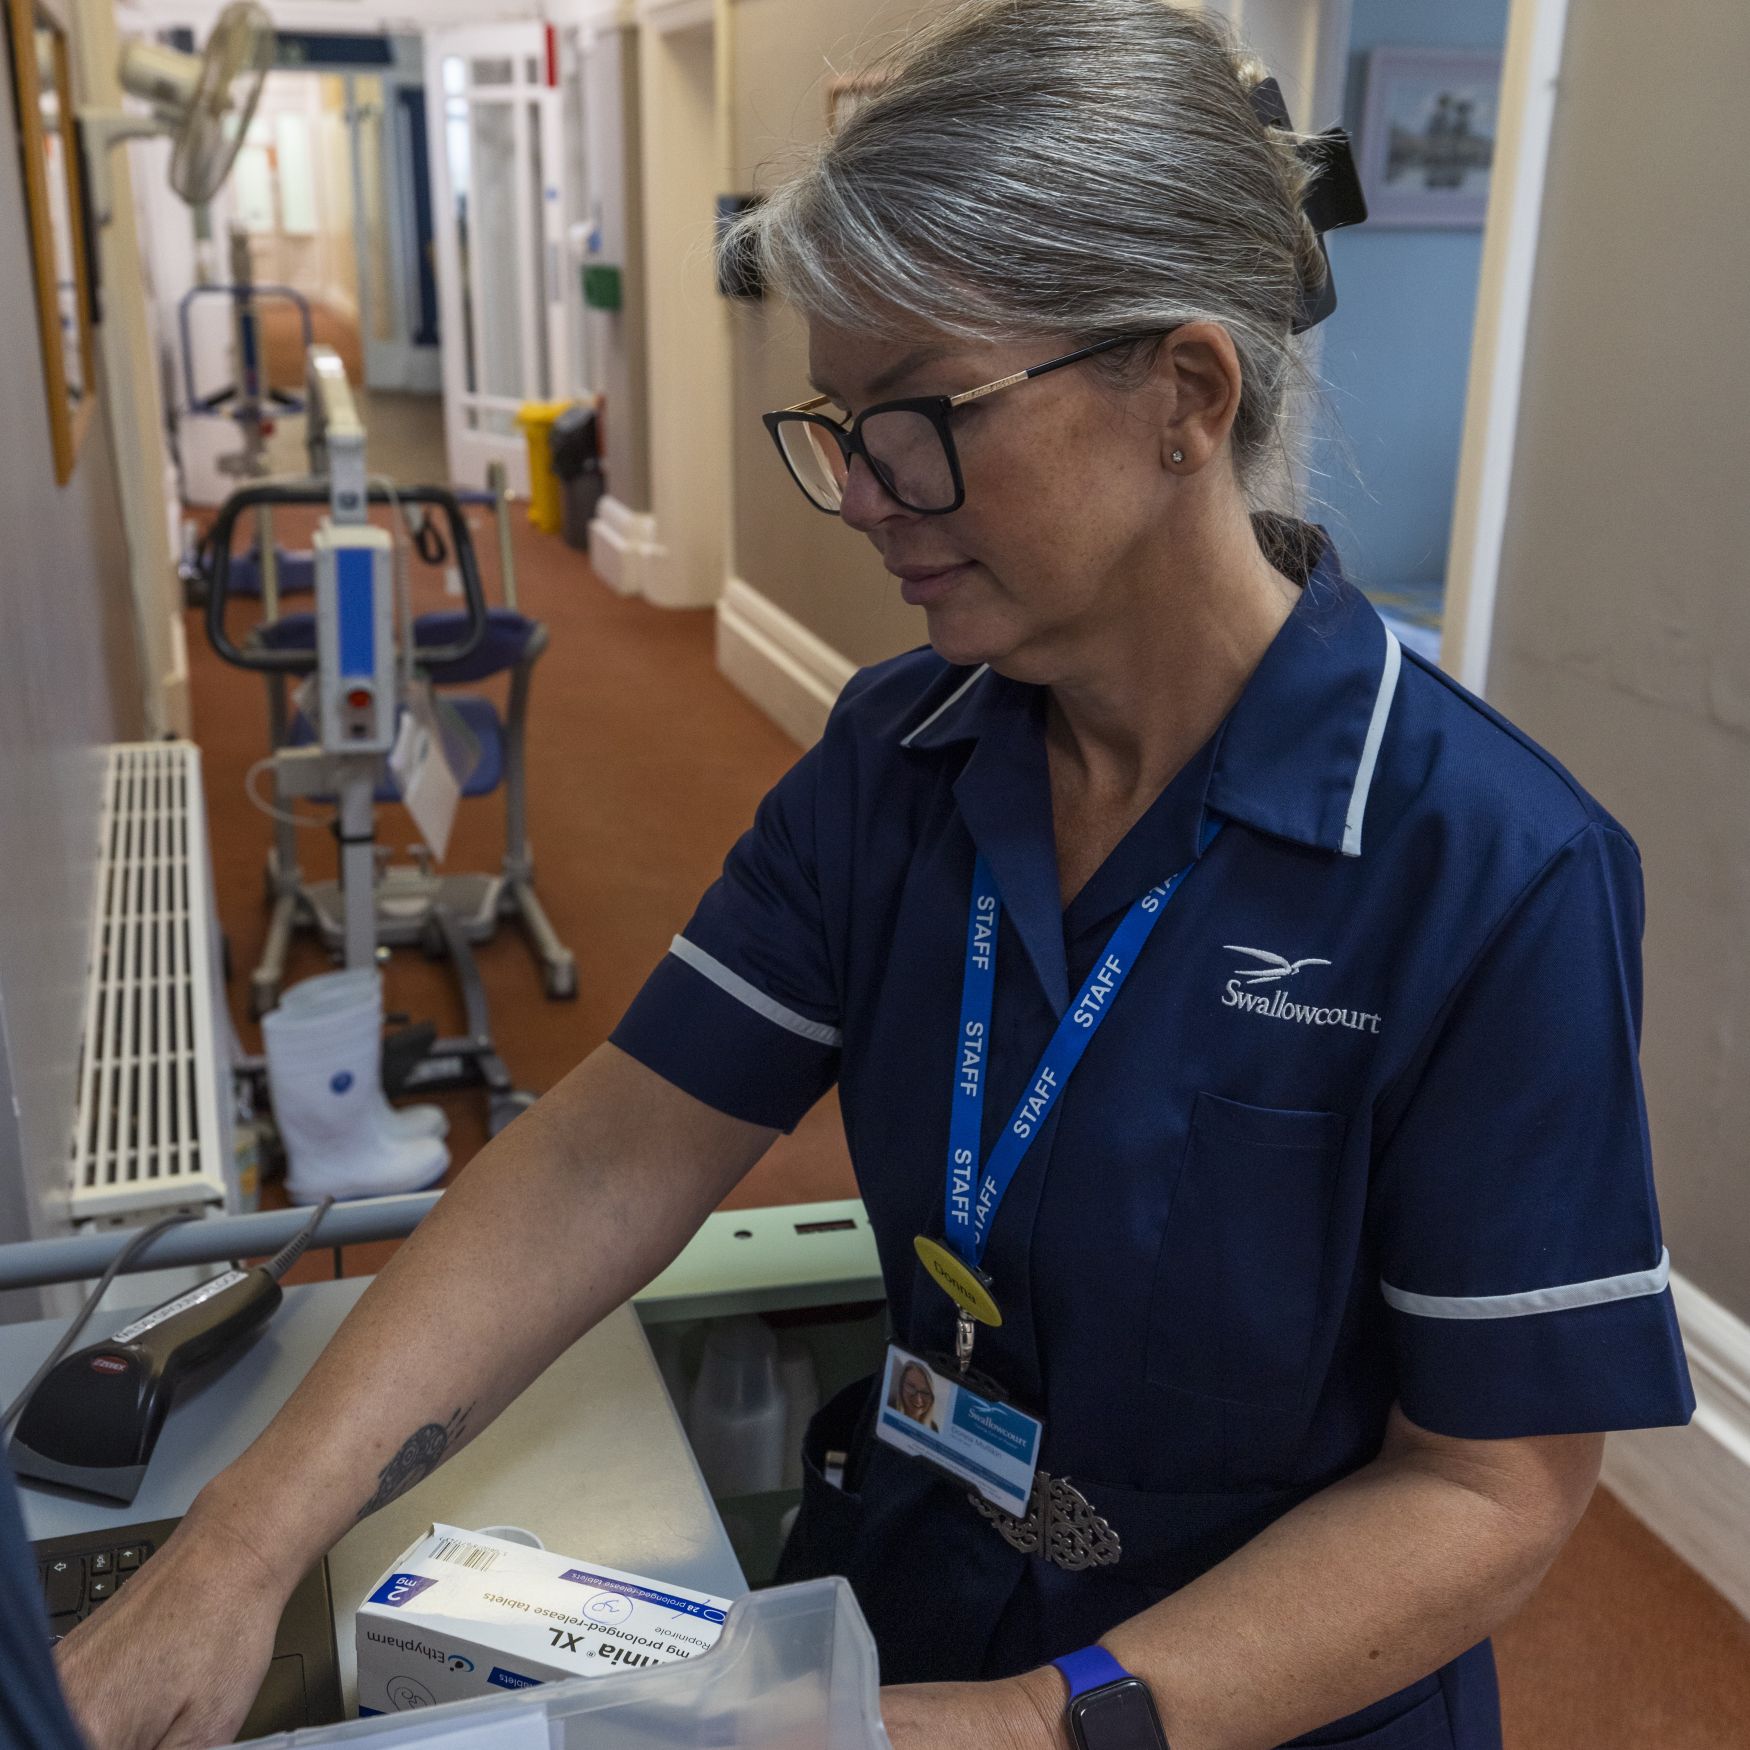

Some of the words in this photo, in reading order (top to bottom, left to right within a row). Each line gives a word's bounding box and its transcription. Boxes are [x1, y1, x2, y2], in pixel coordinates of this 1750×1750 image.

[972, 895, 995, 971] STAFF
[1074, 954, 1122, 1028] STAFF
[1221, 979, 1382, 1034] Swallowcourt
[960, 1021, 984, 1097] STAFF
[1013, 1066, 1057, 1139] STAFF
[951, 1148, 972, 1226] STAFF
[933, 1260, 977, 1305] Donna
[967, 1407, 1027, 1448] Swallowcourt
[387, 1585, 411, 1601] 2
[396, 1577, 417, 1588] mg
[571, 1573, 603, 1586] tablets
[604, 1581, 687, 1608] prolonged-release
[482, 1592, 531, 1612] tablets
[686, 1604, 701, 1613] 28
[534, 1607, 663, 1650] prolonged-release
[549, 1627, 585, 1653] XL
[654, 1626, 711, 1650] Ropinirole
[367, 1631, 445, 1664] Ethypharm
[666, 1646, 690, 1659] mg
